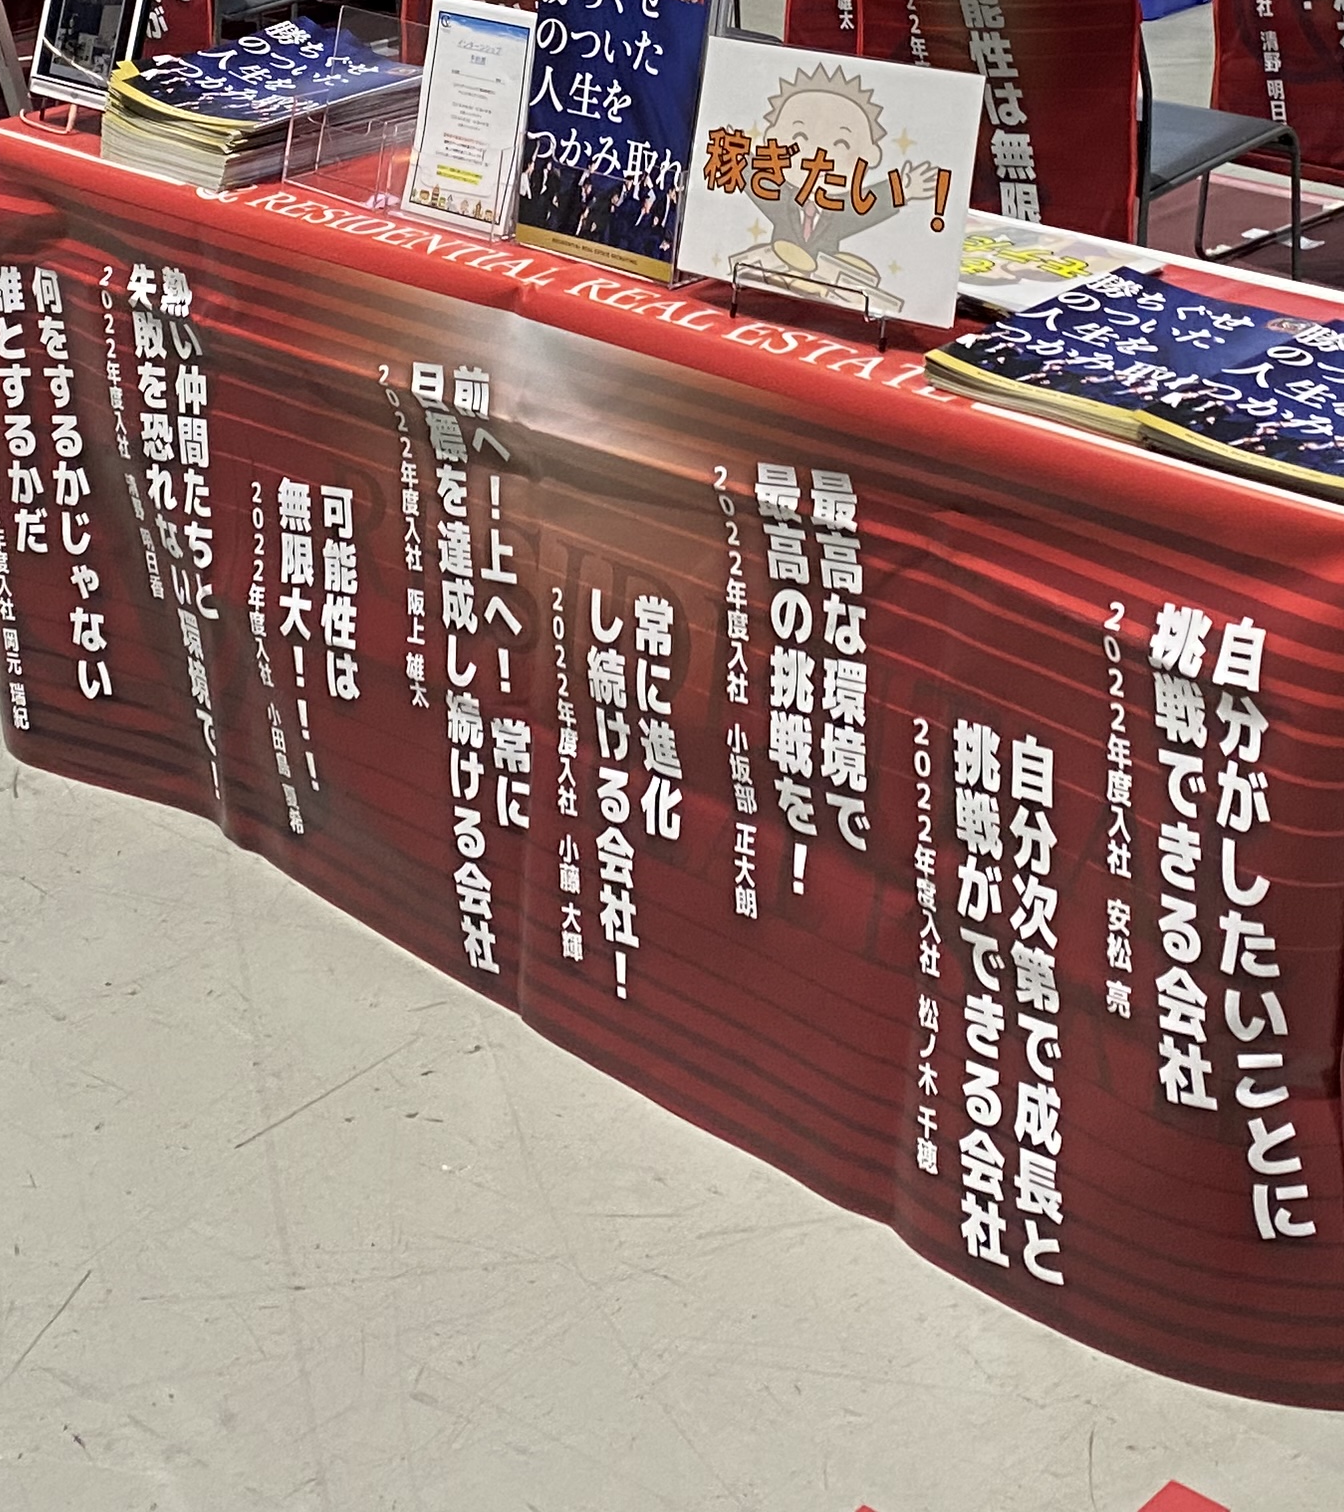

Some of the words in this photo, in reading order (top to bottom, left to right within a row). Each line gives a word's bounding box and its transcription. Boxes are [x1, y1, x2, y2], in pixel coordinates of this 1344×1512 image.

[526, 128, 686, 202] つかみ取れ
[529, 65, 633, 125] 人生を
[536, 17, 665, 76] のついた
[246, 189, 562, 286] RESIDENTIAL
[564, 275, 717, 332] REAL
[702, 126, 953, 233] 稼ぎたい！
[1084, 273, 1256, 331] 勝ちぐせ
[99, 265, 132, 460] 2022年度入社
[160, 266, 221, 620] 熱い仲間たちと
[1015, 306, 1160, 356] 人生を
[1058, 290, 1226, 350] のついた
[30, 266, 113, 700] 何をするかじゃない
[247, 480, 276, 689] 2022年度入社
[319, 484, 361, 701] 可能性は
[377, 363, 425, 573] 2022年度入社
[404, 649, 431, 711] 雄太
[452, 365, 524, 694] 前へ！上へ！
[490, 716, 533, 831] 常に
[712, 465, 750, 707] 2022年度入社
[277, 476, 320, 792] 無限大！！！
[411, 361, 501, 976] 目標を達成し続ける会社
[550, 587, 580, 819] 2022年度入社
[633, 594, 684, 842] 常に進化
[754, 460, 819, 897] 最高の挑戦を！
[809, 467, 872, 853] 最高な環境で
[1101, 600, 1135, 881] 2022年度入社
[585, 587, 641, 1001] し続ける会社！
[911, 717, 943, 980] 2022年度入社
[1148, 601, 1220, 1113] 挑戦できる会社
[951, 717, 1012, 1270] 挑戦ができる会社
[1008, 733, 1067, 1288] 自分次第で成長と
[1210, 615, 1319, 1241] 自分がしたいことに
